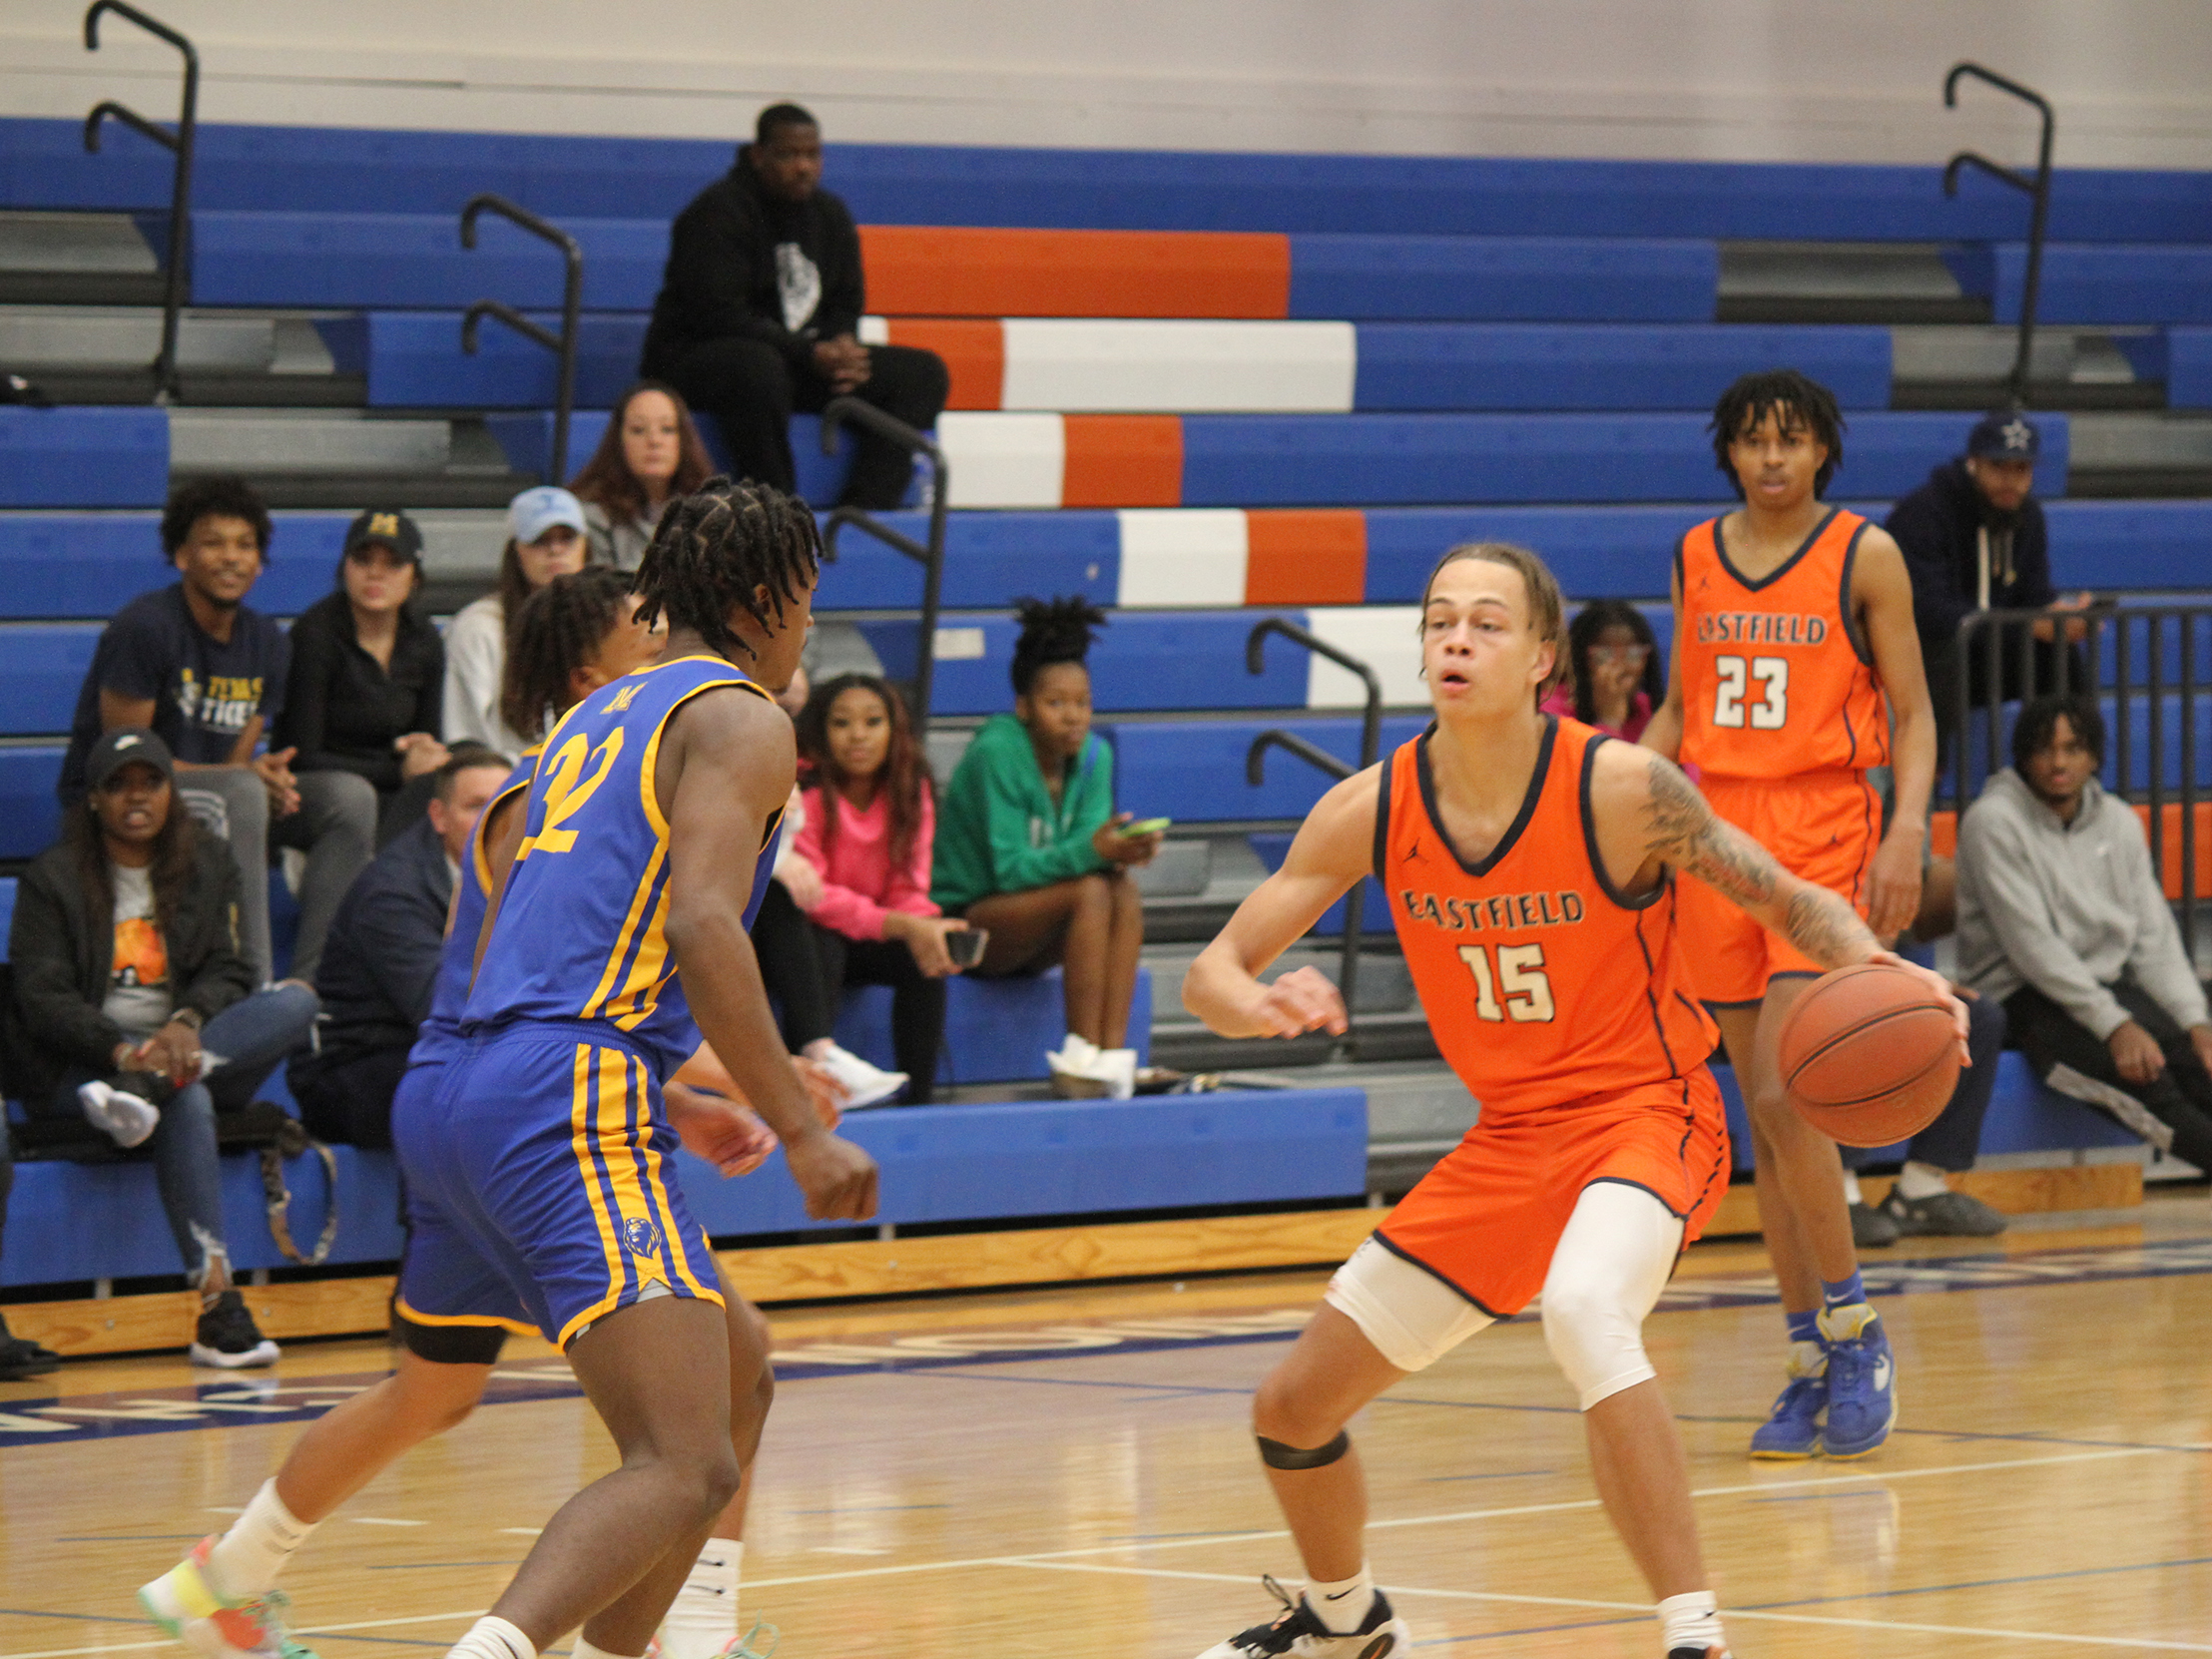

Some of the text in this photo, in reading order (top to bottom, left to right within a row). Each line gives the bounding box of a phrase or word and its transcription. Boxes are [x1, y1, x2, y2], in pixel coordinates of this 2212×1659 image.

[1713, 655, 1789, 730] 23
[1399, 889, 1585, 931] EASTFIELD
[1457, 942, 1555, 1023] 15
